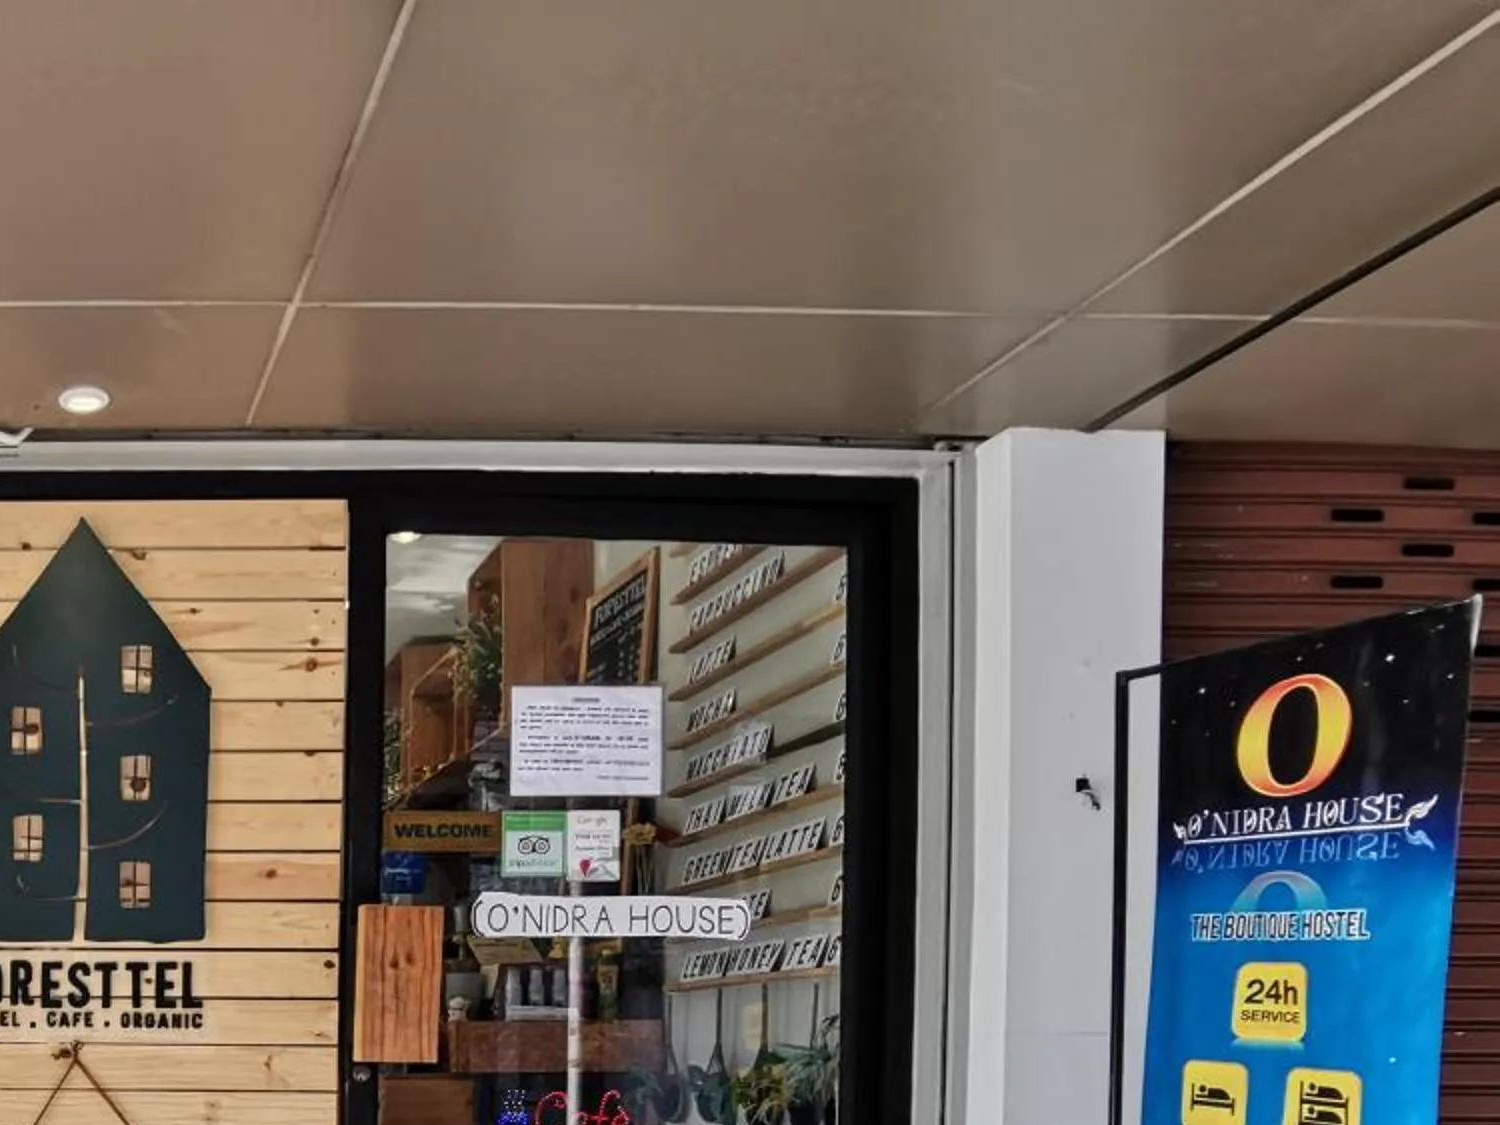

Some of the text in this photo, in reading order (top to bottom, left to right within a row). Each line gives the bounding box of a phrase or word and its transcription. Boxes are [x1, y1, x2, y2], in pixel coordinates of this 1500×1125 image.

[1237, 673, 1353, 797] O
[776, 766, 811, 801] TEA
[394, 823, 494, 839] WELCOME
[1187, 793, 1405, 839] O'NIDRA HOUSE
[683, 851, 730, 884] GREEN
[730, 841, 761, 871] TEA
[764, 822, 822, 860] LATTE
[1191, 908, 1371, 942] THE BOUTIQUE HOSTEL
[683, 952, 727, 980] LEMON
[729, 942, 781, 973] HONEY
[787, 937, 822, 966] TEA
[1244, 978, 1298, 1005] 24h
[46, 1011, 94, 1028] CAFE
[120, 1012, 203, 1029] ORGANIC
[1240, 1009, 1301, 1024] SERVICE
